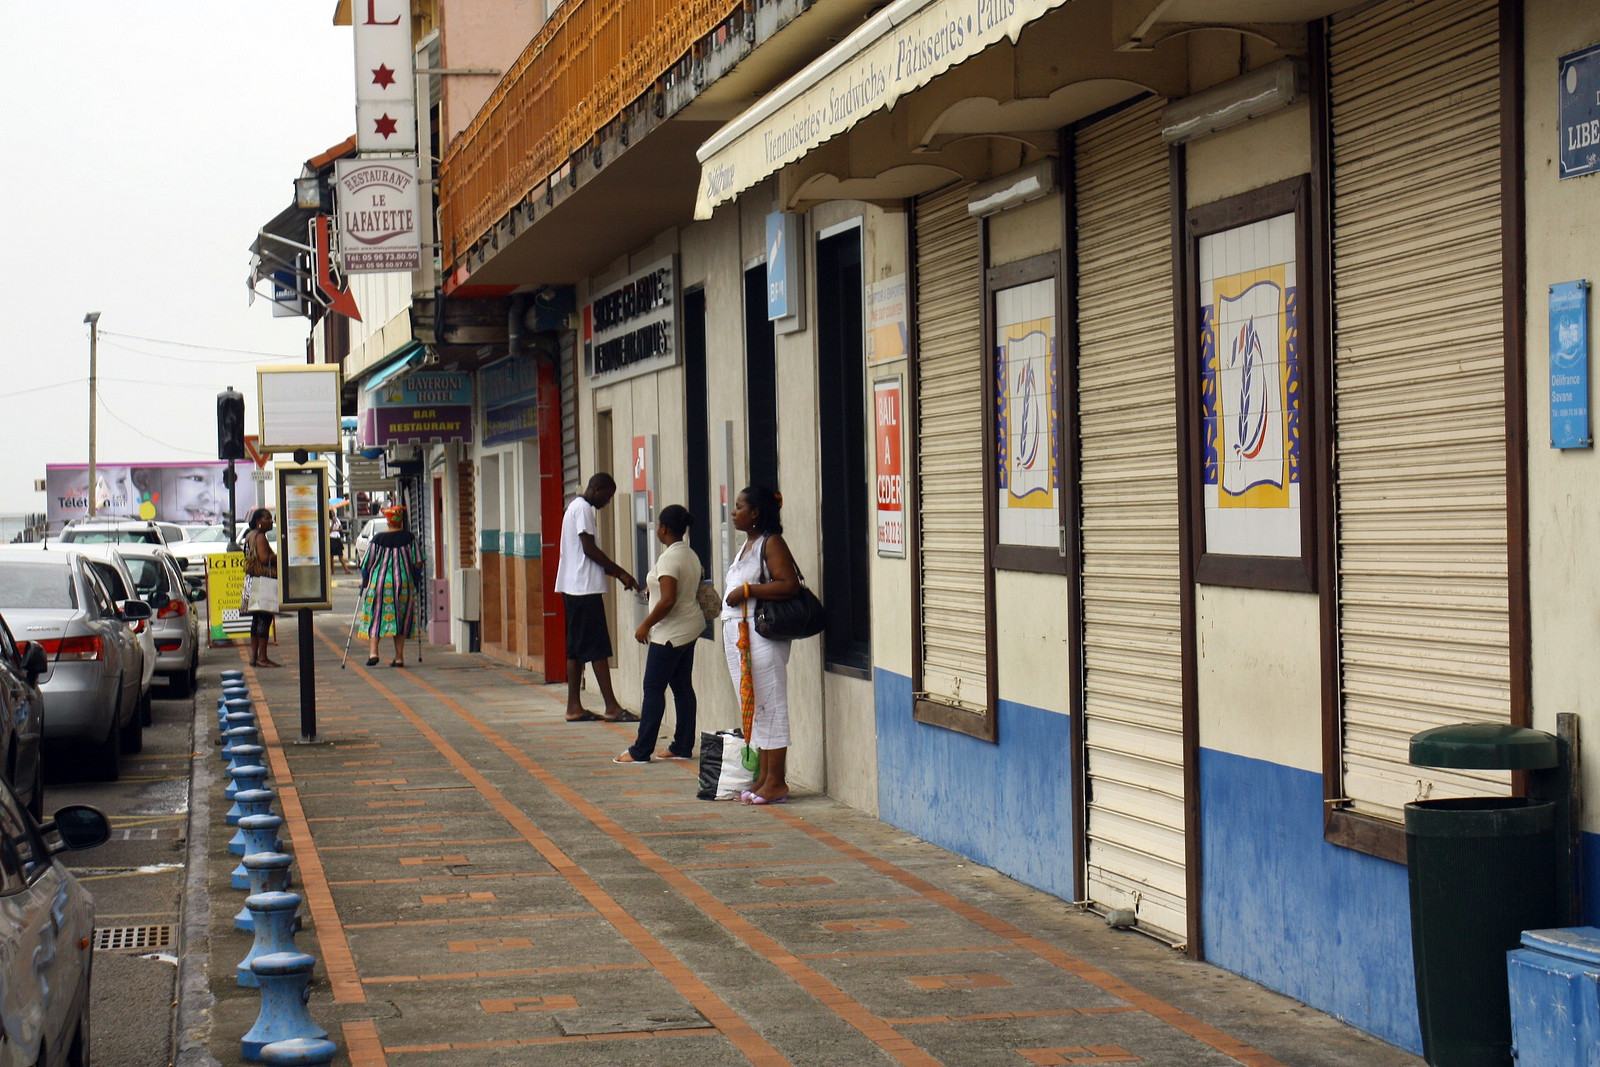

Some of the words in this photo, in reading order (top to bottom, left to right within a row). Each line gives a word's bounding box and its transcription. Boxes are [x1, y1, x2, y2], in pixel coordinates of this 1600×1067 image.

[764, 106, 821, 165] Viennoiseries
[895, 10, 964, 82] Pâtisseries
[344, 169, 411, 191] RESTAURANT
[372, 194, 386, 207] LE
[345, 209, 413, 233] LAFAYETTE
[1552, 374, 1580, 386] Délifrance
[418, 391, 453, 402] HOTEL
[1552, 391, 1573, 402] Savane
[413, 410, 436, 419] BAR
[879, 396, 896, 426] BAIL
[389, 422, 461, 432] RESTAURANT
[885, 436, 891, 464] A
[877, 475, 902, 503] CEDER
